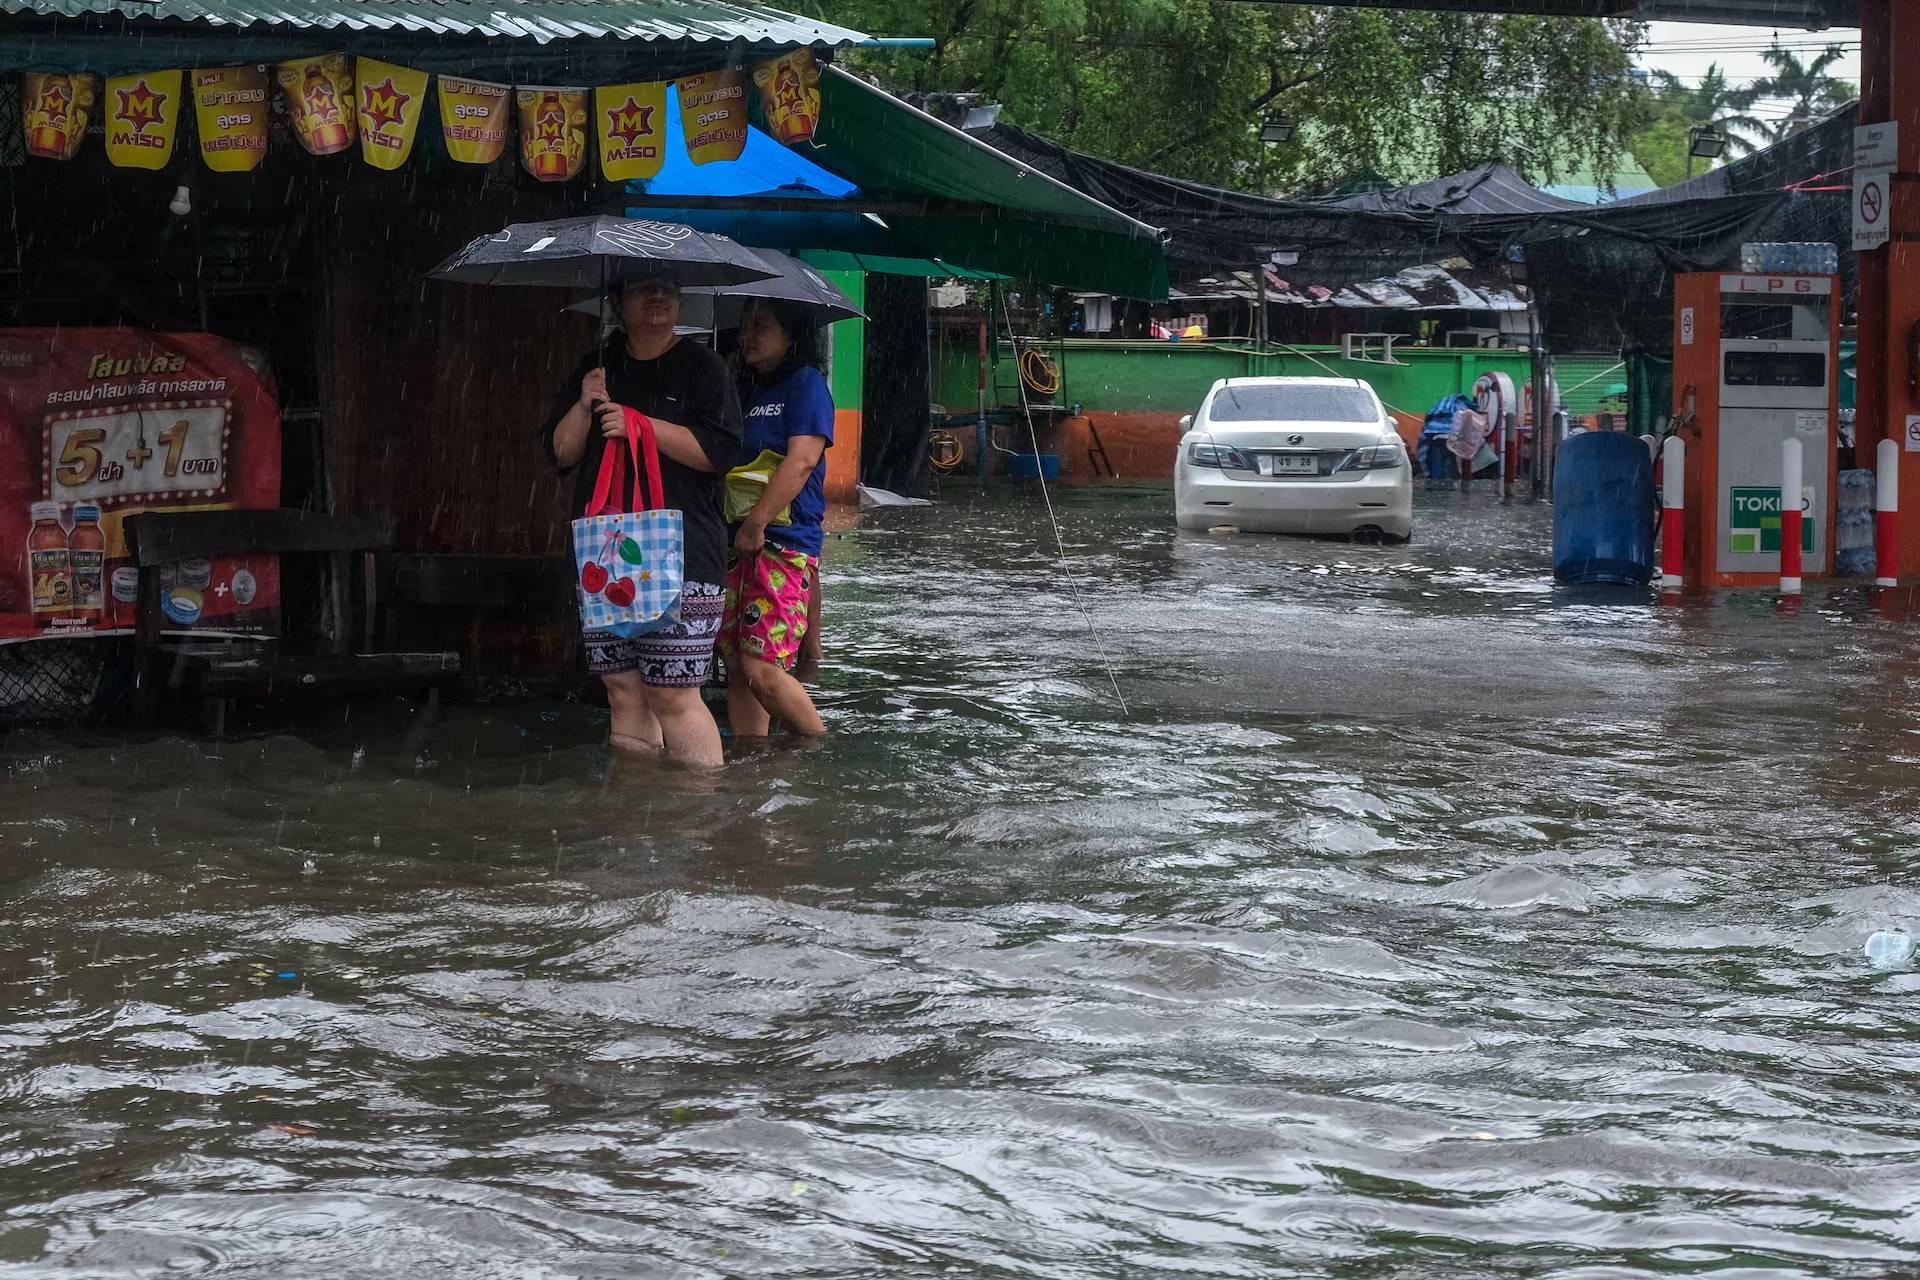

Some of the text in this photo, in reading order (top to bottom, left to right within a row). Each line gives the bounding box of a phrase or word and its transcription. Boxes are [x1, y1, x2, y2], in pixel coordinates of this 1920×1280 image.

[125, 94, 156, 118] M
[368, 90, 399, 119] M
[454, 103, 490, 120] สูตร
[216, 113, 252, 129] สูตร
[616, 110, 645, 133] M
[697, 109, 730, 127] สูตร
[112, 132, 166, 149] M-150
[606, 146, 657, 163] M-150
[56, 428, 107, 487] 5
[99, 462, 124, 482] ฝา
[158, 420, 189, 477] 1
[183, 457, 219, 474] บาท
